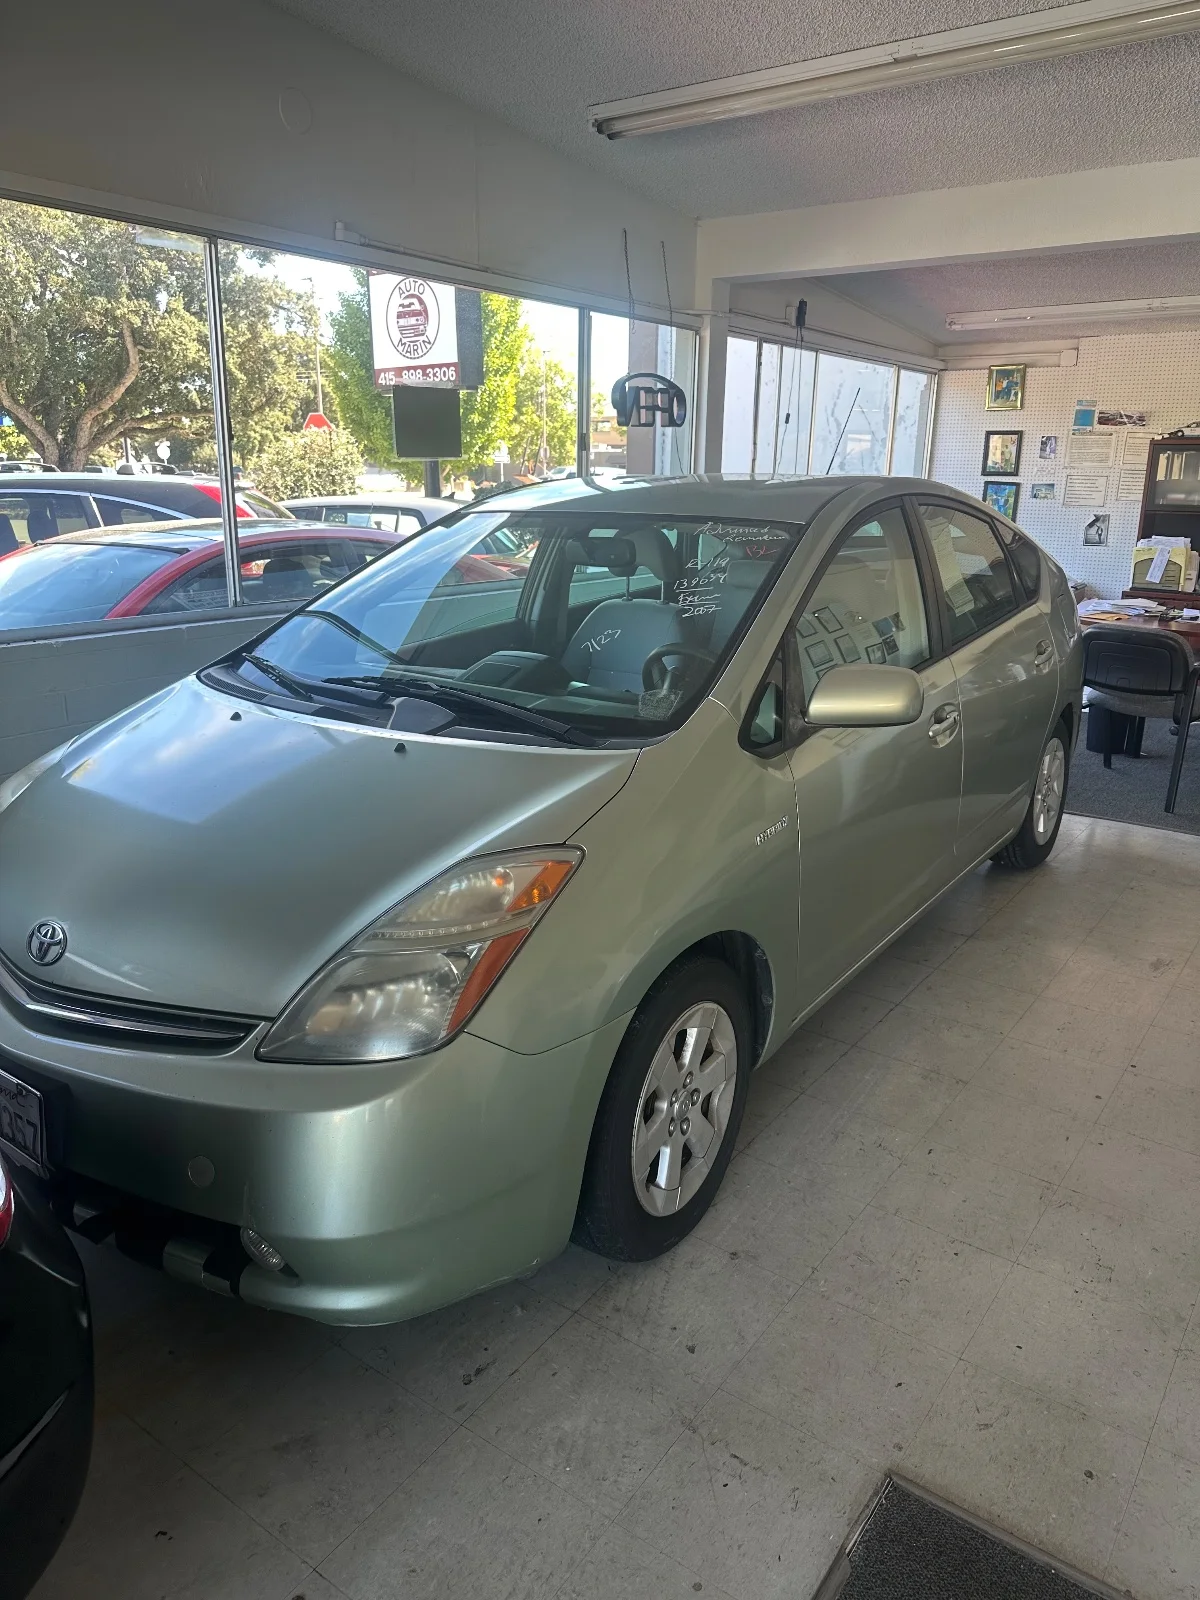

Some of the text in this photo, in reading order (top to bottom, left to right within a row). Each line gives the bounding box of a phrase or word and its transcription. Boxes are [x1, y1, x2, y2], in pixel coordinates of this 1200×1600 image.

[398, 280, 426, 299] AUTO
[397, 335, 432, 357] MARIN
[378, 366, 456, 385] 415 898-3306
